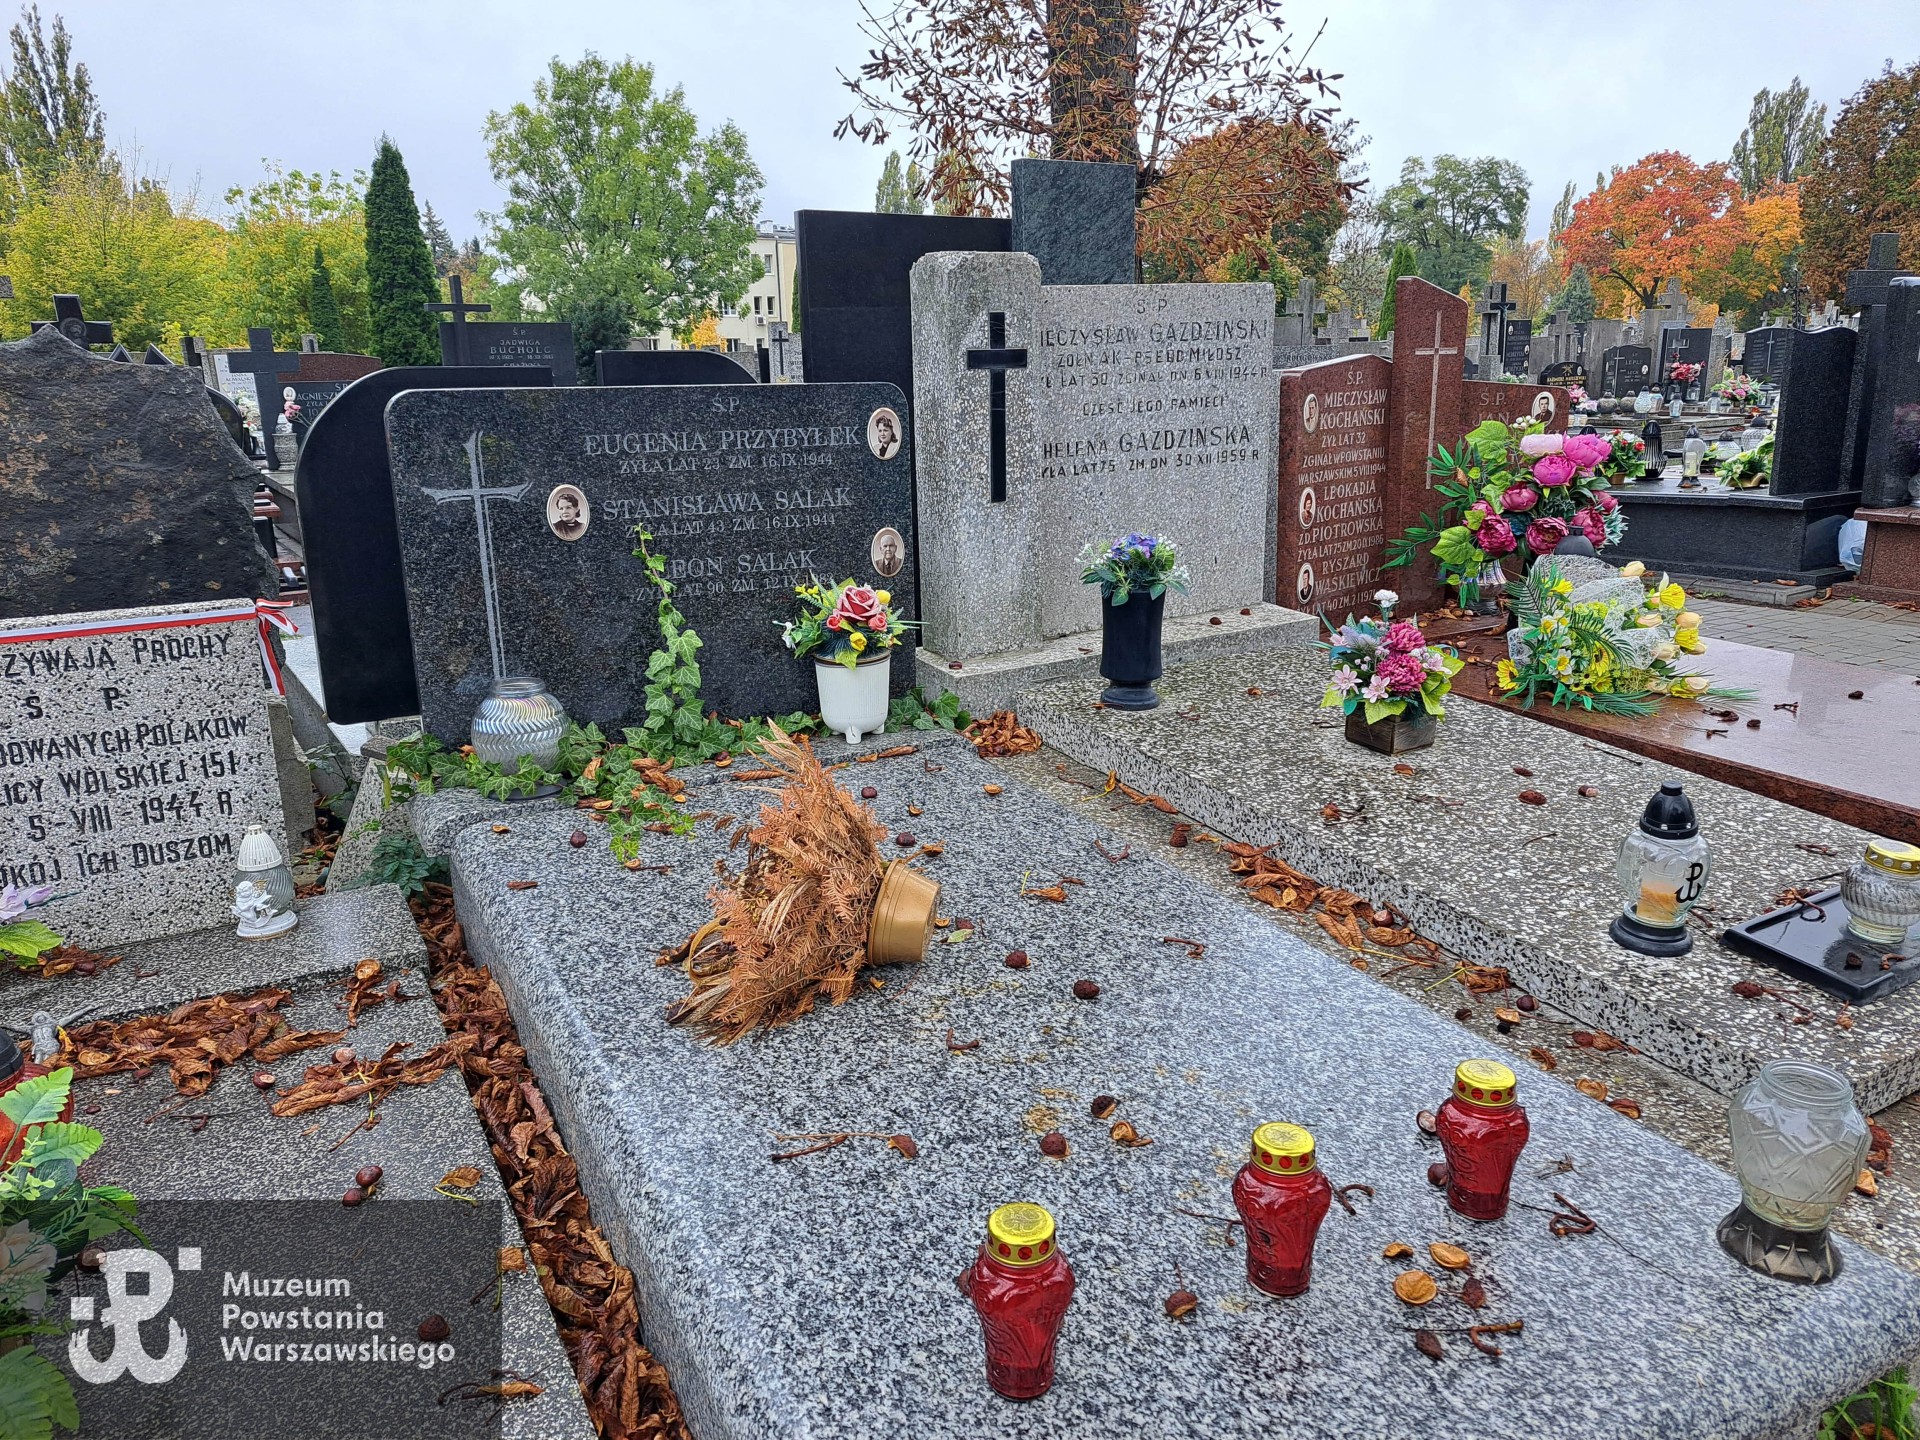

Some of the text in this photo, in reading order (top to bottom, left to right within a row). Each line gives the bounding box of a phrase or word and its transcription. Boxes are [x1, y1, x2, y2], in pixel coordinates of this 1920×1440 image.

[490, 346, 551, 354] BUCHOLC
[1194, 367, 1201, 381] 6
[1229, 364, 1258, 381] 1944
[1130, 397, 1162, 413] JEGO
[1324, 388, 1388, 409] MIECZYSŁAW
[1319, 408, 1386, 430] KOCHAŃSKI
[584, 426, 861, 456] EUGENIA PRZYBYŁEK
[1043, 439, 1108, 459] HELENA
[1321, 431, 1366, 448] ŻYŁ LAT 32
[667, 456, 699, 472] LAT
[703, 457, 720, 470] 23
[1073, 462, 1097, 476] LAT
[1176, 453, 1192, 467] 30
[1198, 453, 1212, 464] XII
[1216, 448, 1246, 463] 1959
[1252, 449, 1259, 460] R
[1298, 466, 1353, 486] WARSZAWSKIM
[1323, 479, 1376, 501] LEOKADIA
[603, 487, 852, 521] STANISŁAWA SALAK
[1316, 496, 1384, 523] KOCHAŃSKA
[673, 520, 704, 536] LAT
[707, 519, 725, 533] 43
[738, 549, 817, 573] SALAK
[1320, 544, 1333, 558] LAT
[1322, 552, 1370, 575] RYSZARD
[707, 580, 724, 595] 90
[132, 633, 230, 665] PROCHY
[100, 687, 119, 711] P
[58, 759, 188, 797] WOLSKIEJ
[200, 750, 236, 779] 151
[27, 814, 46, 842] 5
[69, 803, 113, 837] VIII
[140, 791, 204, 826] 1944
[217, 790, 233, 816] R
[76, 850, 119, 878] ICH
[131, 833, 232, 869] DUSZOM
